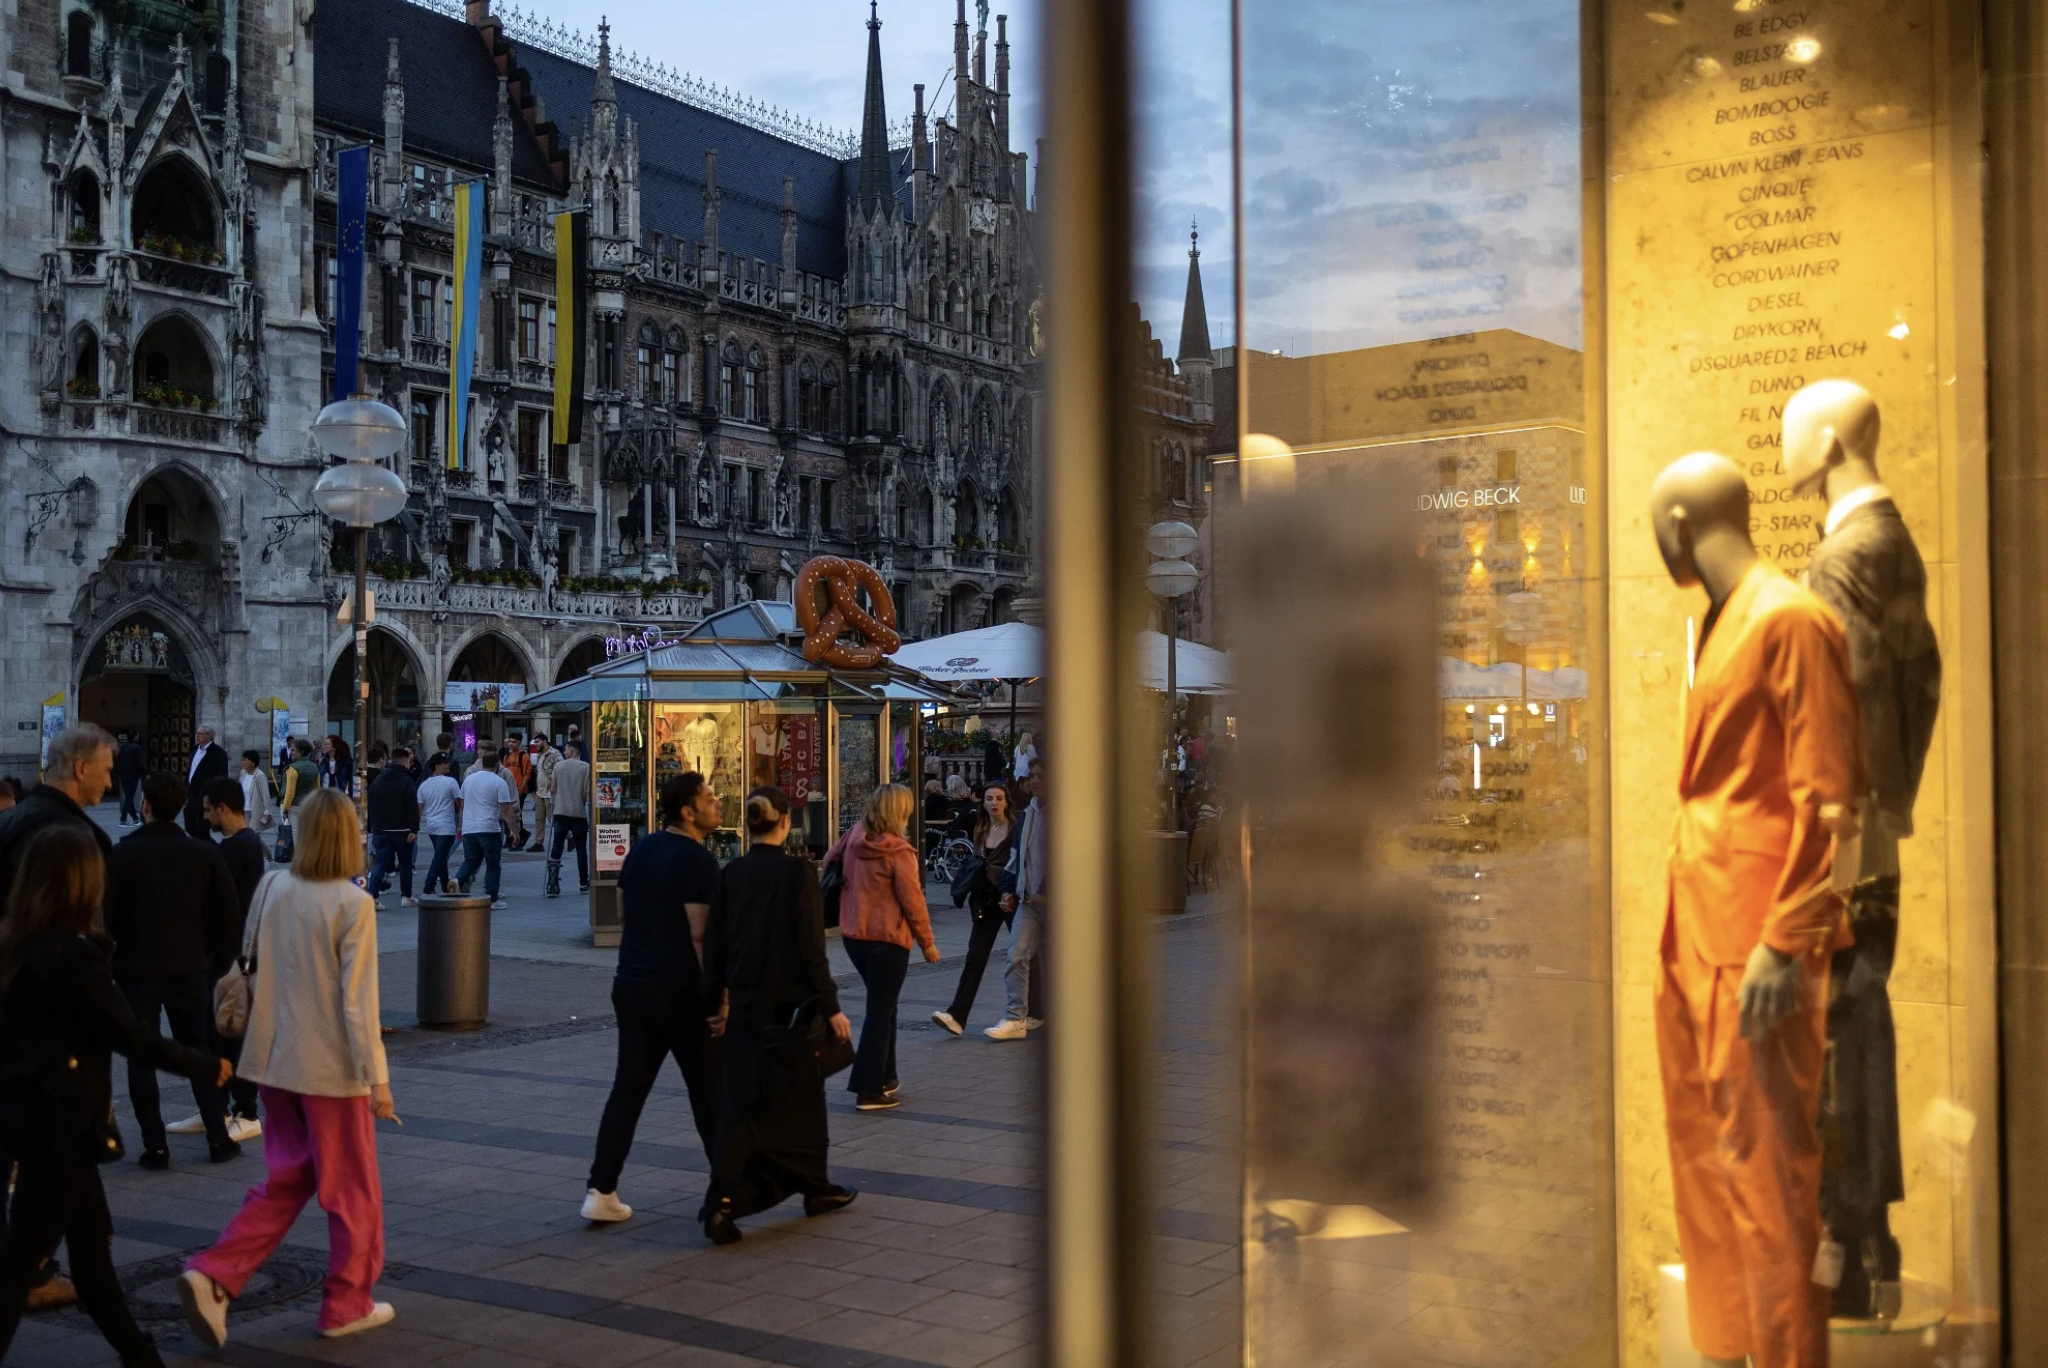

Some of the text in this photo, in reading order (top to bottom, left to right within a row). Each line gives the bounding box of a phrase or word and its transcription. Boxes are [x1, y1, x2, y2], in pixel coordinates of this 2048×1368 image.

[1733, 11, 1811, 39] BE EDGY
[1739, 68, 1805, 92] BLAUER
[1714, 91, 1831, 124] BOMBOOGIE
[1748, 125, 1797, 147] BOSS
[1685, 160, 1749, 183] CALVIN
[1739, 179, 1812, 202] CINQUE
[1734, 206, 1818, 231] COLMAR
[1710, 231, 1842, 263] COPENHAGEN
[1711, 259, 1841, 288] CORDWAINER
[1733, 318, 1822, 341] DRYKORN
[1689, 340, 1867, 374] DSQUARED2 BEACH
[1748, 375, 1805, 395] DUNO
[1473, 486, 1521, 507] BECK
[1569, 486, 1588, 505] LUD
[1749, 515, 1812, 533] G-STAR
[1546, 705, 1554, 715] U
[797, 749, 808, 771] FC
[813, 755, 821, 767] FC
